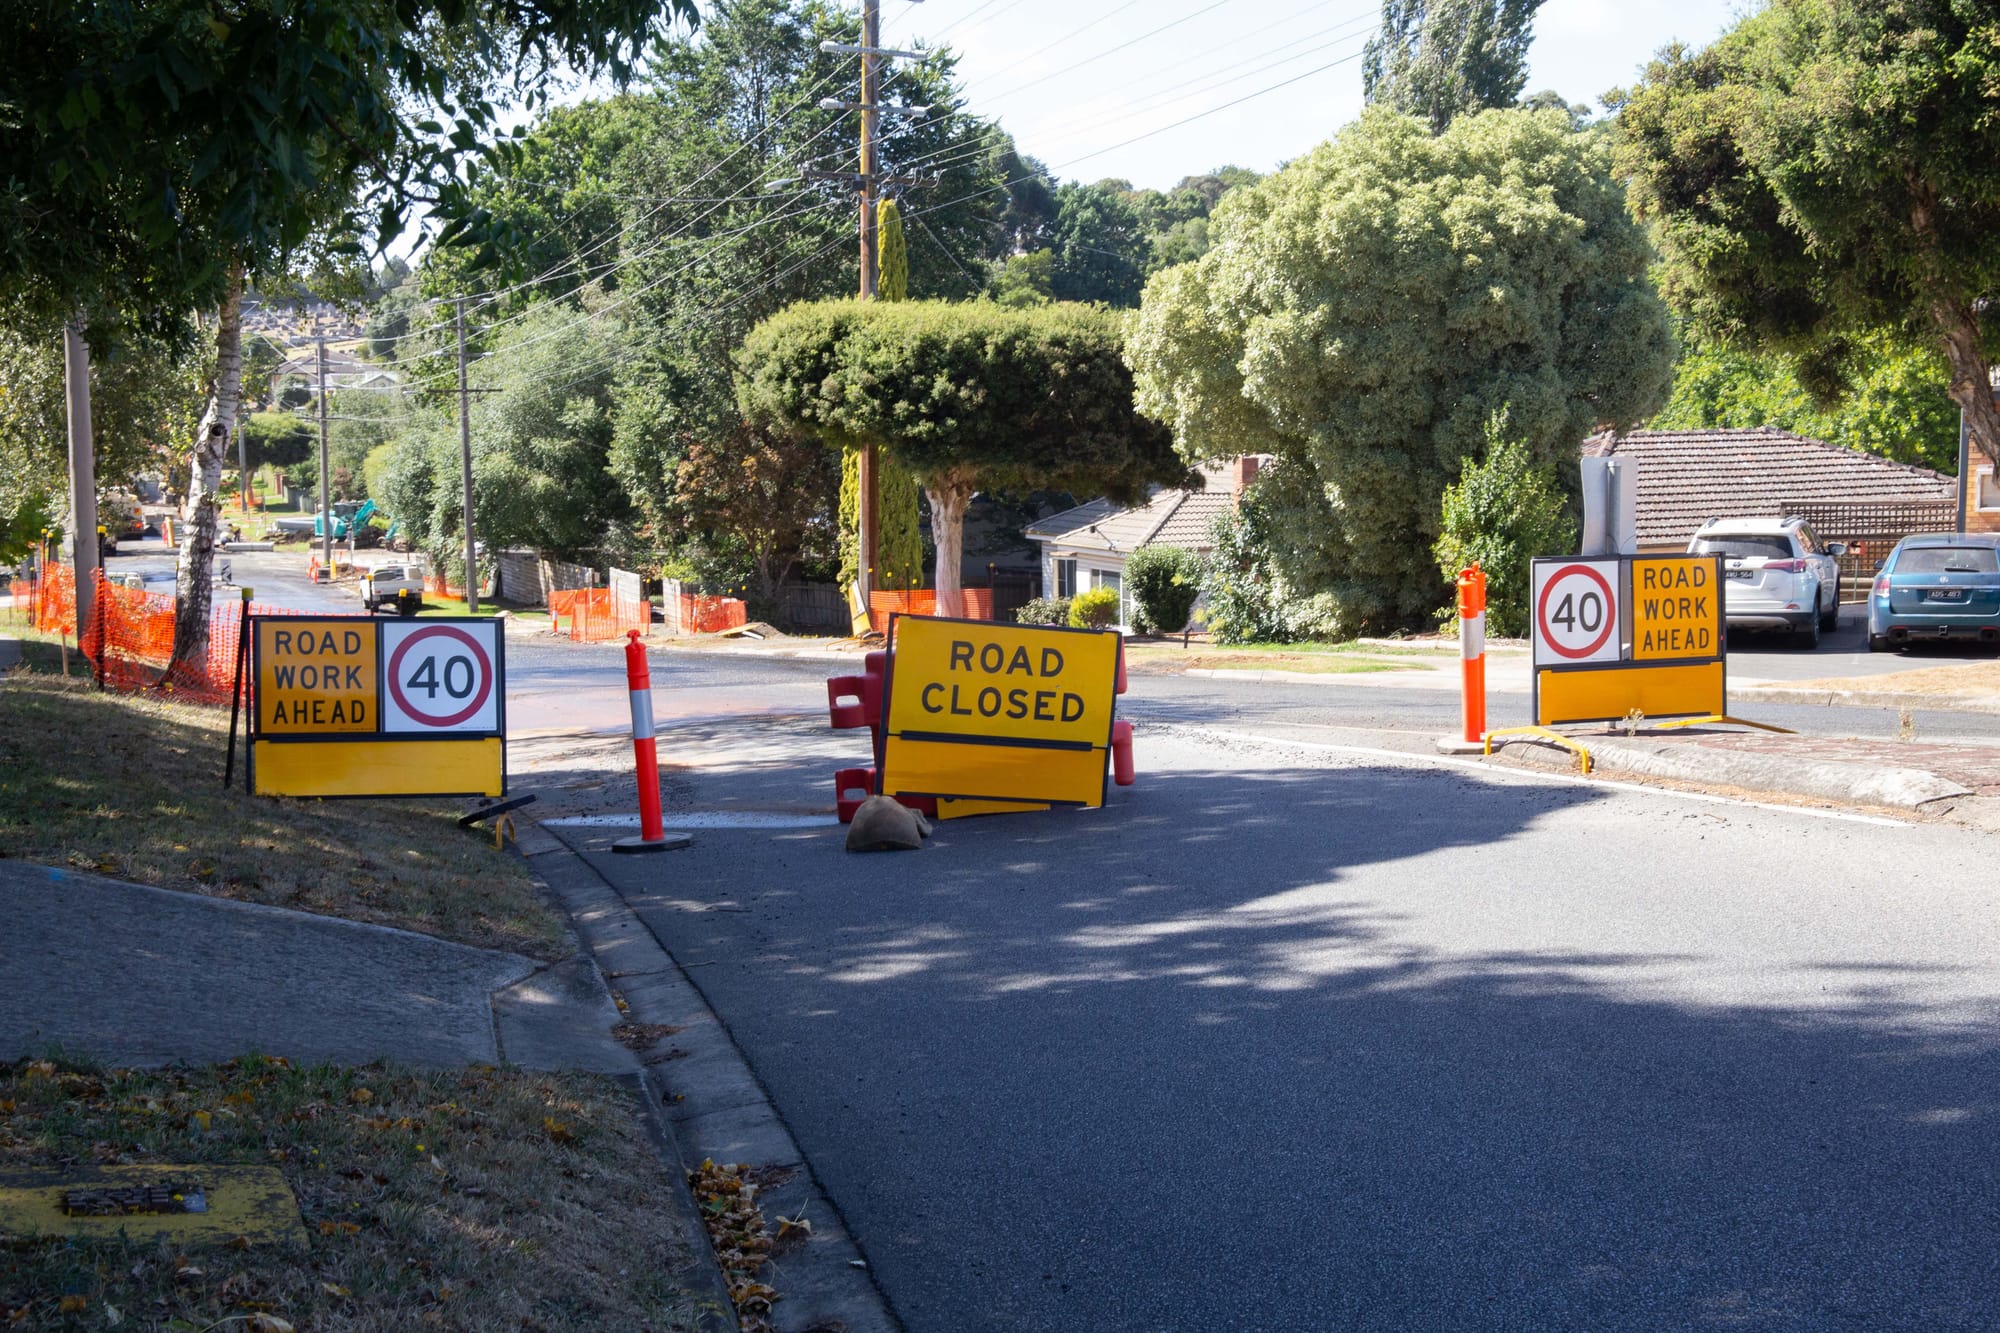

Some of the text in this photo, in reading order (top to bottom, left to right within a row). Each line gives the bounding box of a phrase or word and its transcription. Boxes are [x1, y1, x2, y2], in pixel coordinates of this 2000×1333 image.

[1643, 566, 1706, 590] ROAD
[1551, 591, 1603, 633] 40
[1643, 596, 1708, 621] WORK
[275, 630, 362, 656] ROAD
[1642, 627, 1710, 652] AHEAD
[949, 640, 1064, 678] ROAD
[273, 664, 363, 691] WORK
[406, 655, 475, 699] 40
[272, 699, 365, 725] AHEAD
[921, 682, 1085, 723] CLOSED
